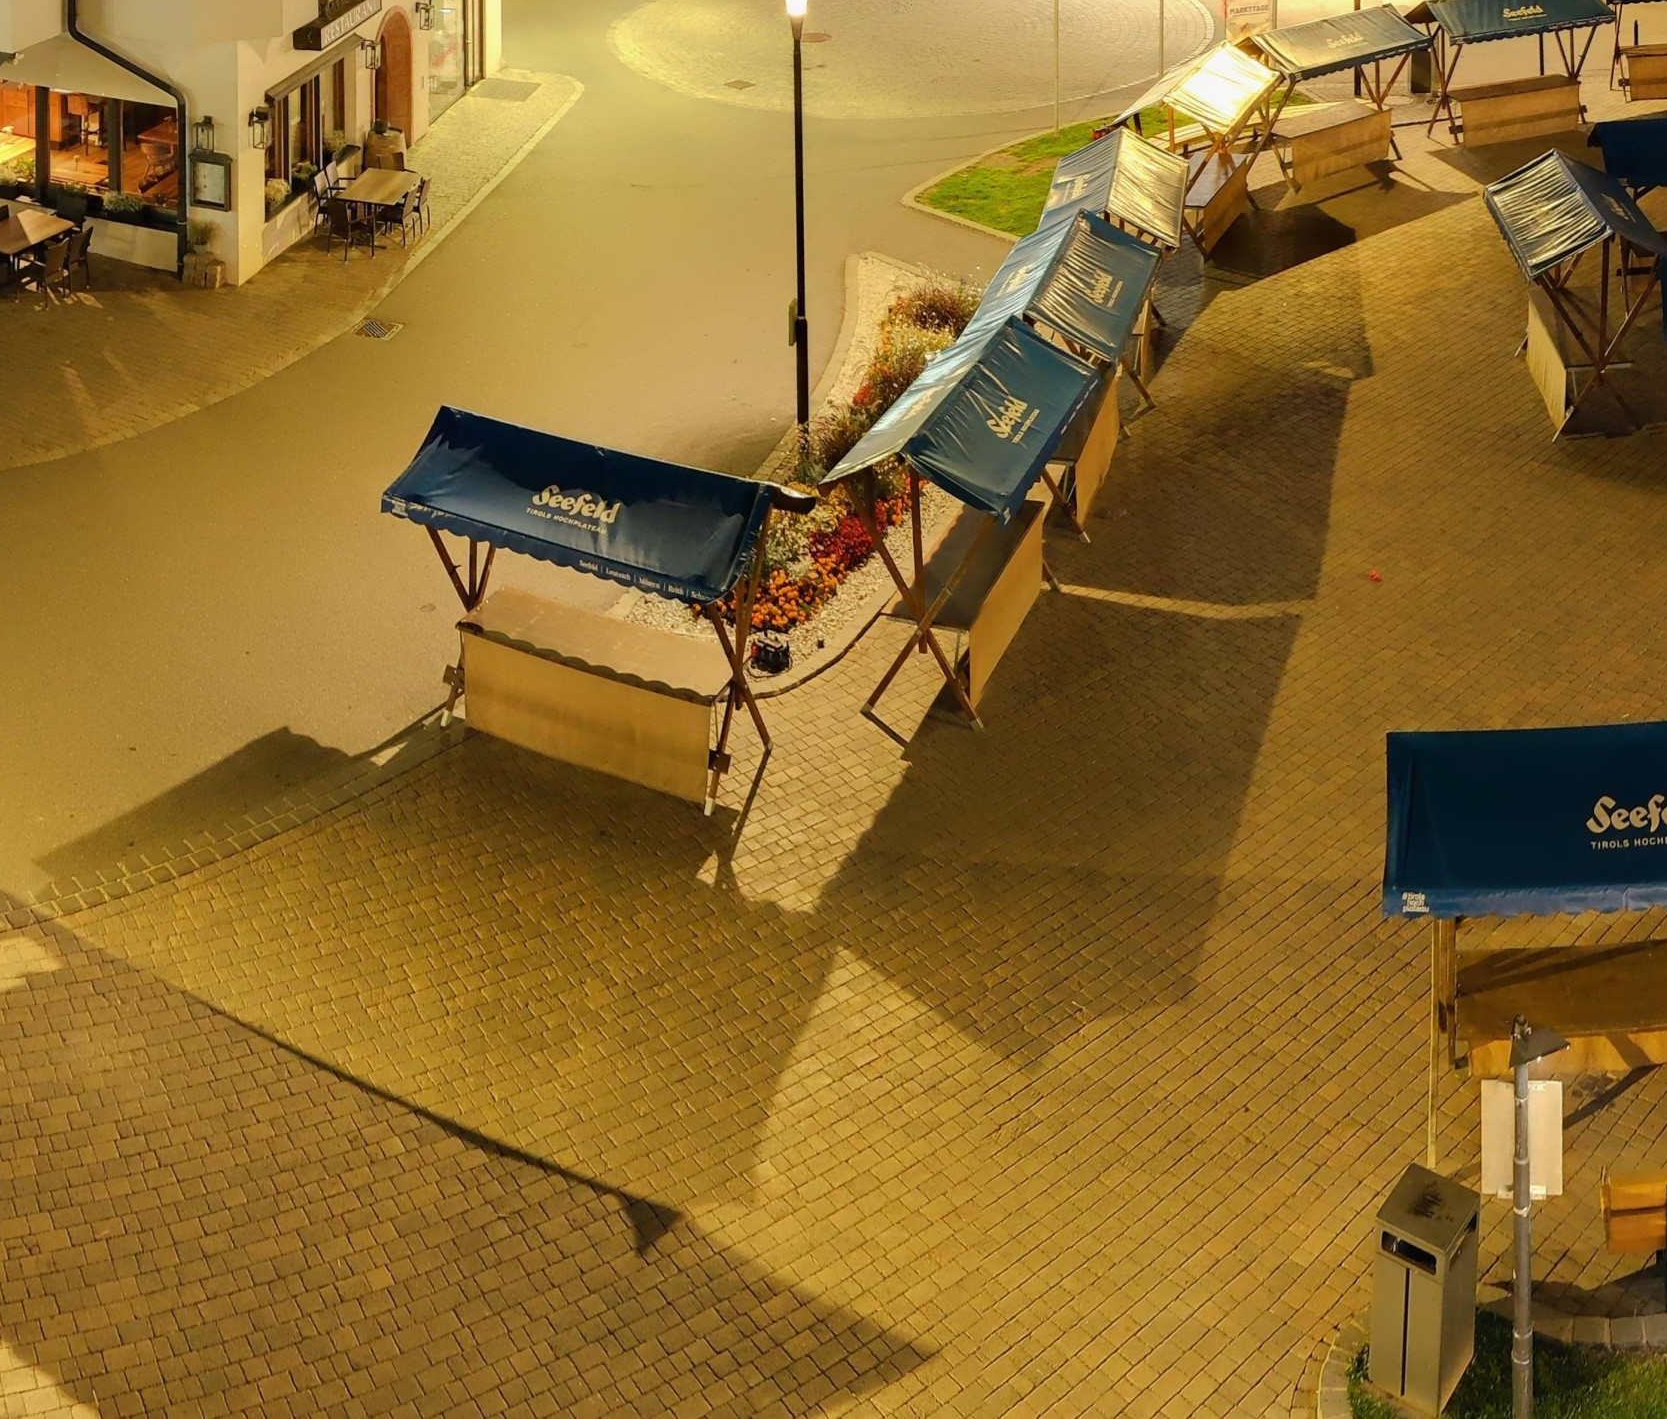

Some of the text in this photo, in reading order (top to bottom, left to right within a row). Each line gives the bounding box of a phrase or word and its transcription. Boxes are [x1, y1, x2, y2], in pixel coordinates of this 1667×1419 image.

[1229, 4, 1270, 15] MARKTTAGE
[1503, 5, 1544, 19] Seefeld
[1326, 32, 1365, 50] Seefeld
[986, 395, 1028, 439] Seefeld
[532, 483, 622, 525] Seefeld
[690, 590, 713, 602] Scharn
[1591, 837, 1629, 850] TIROLS
